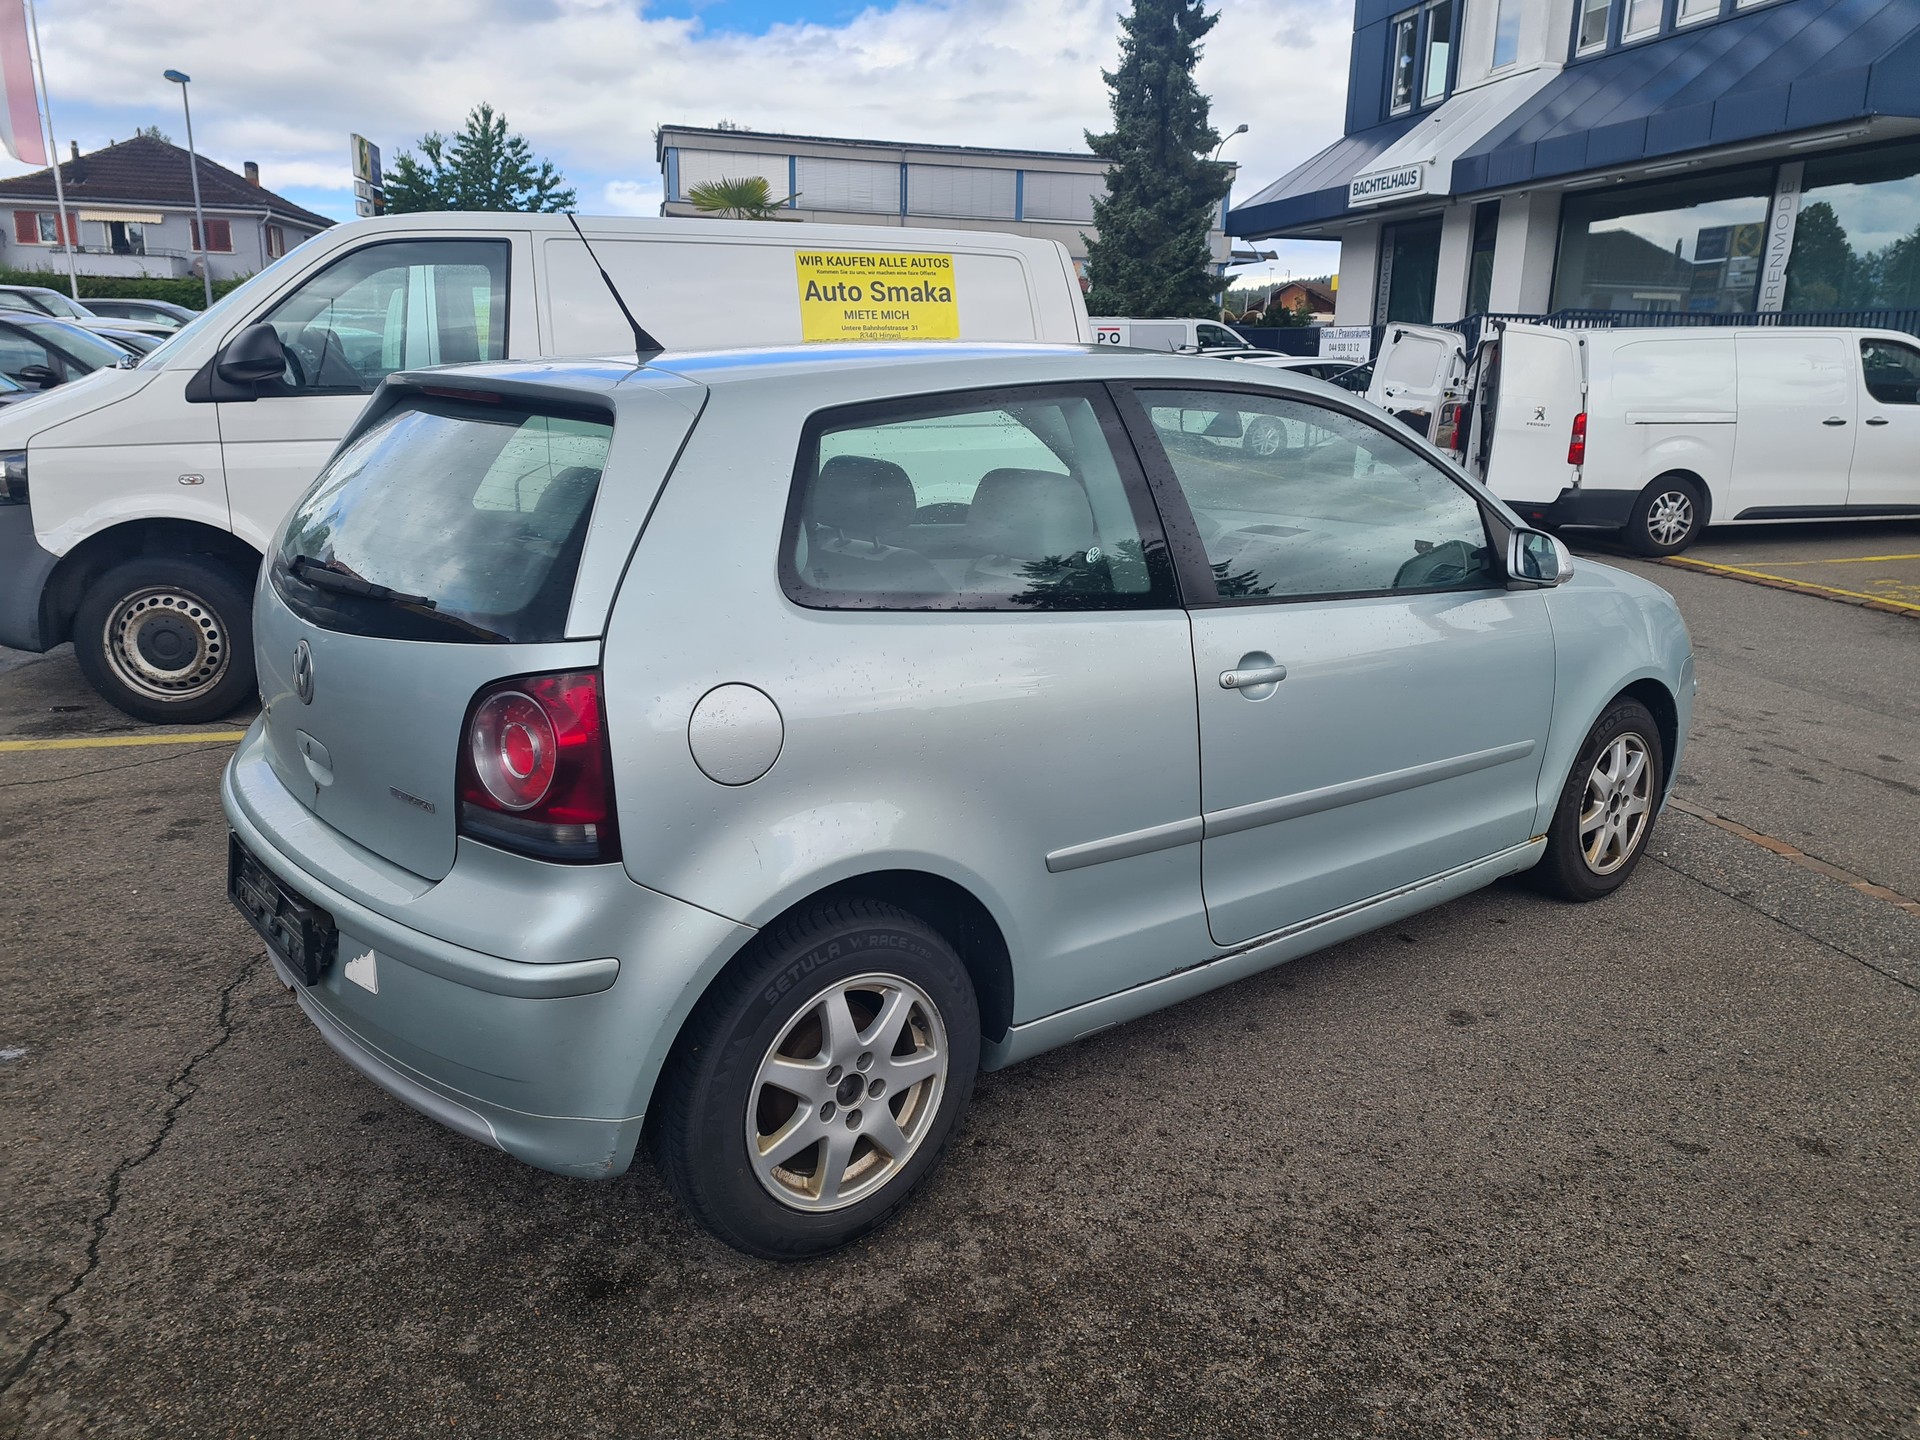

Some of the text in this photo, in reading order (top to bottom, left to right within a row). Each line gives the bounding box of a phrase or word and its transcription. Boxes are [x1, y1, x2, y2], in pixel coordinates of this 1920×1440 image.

[1353, 170, 1417, 196] BACHTELHAUS
[799, 255, 950, 269] WIR KAUFEN ALLE AUTOS
[805, 280, 952, 303] Auto Smaka
[844, 310, 910, 320] MIETE MICH
[1329, 343, 1337, 351] 044
[764, 942, 841, 1006] SETULA
[869, 935, 909, 949] RACE
